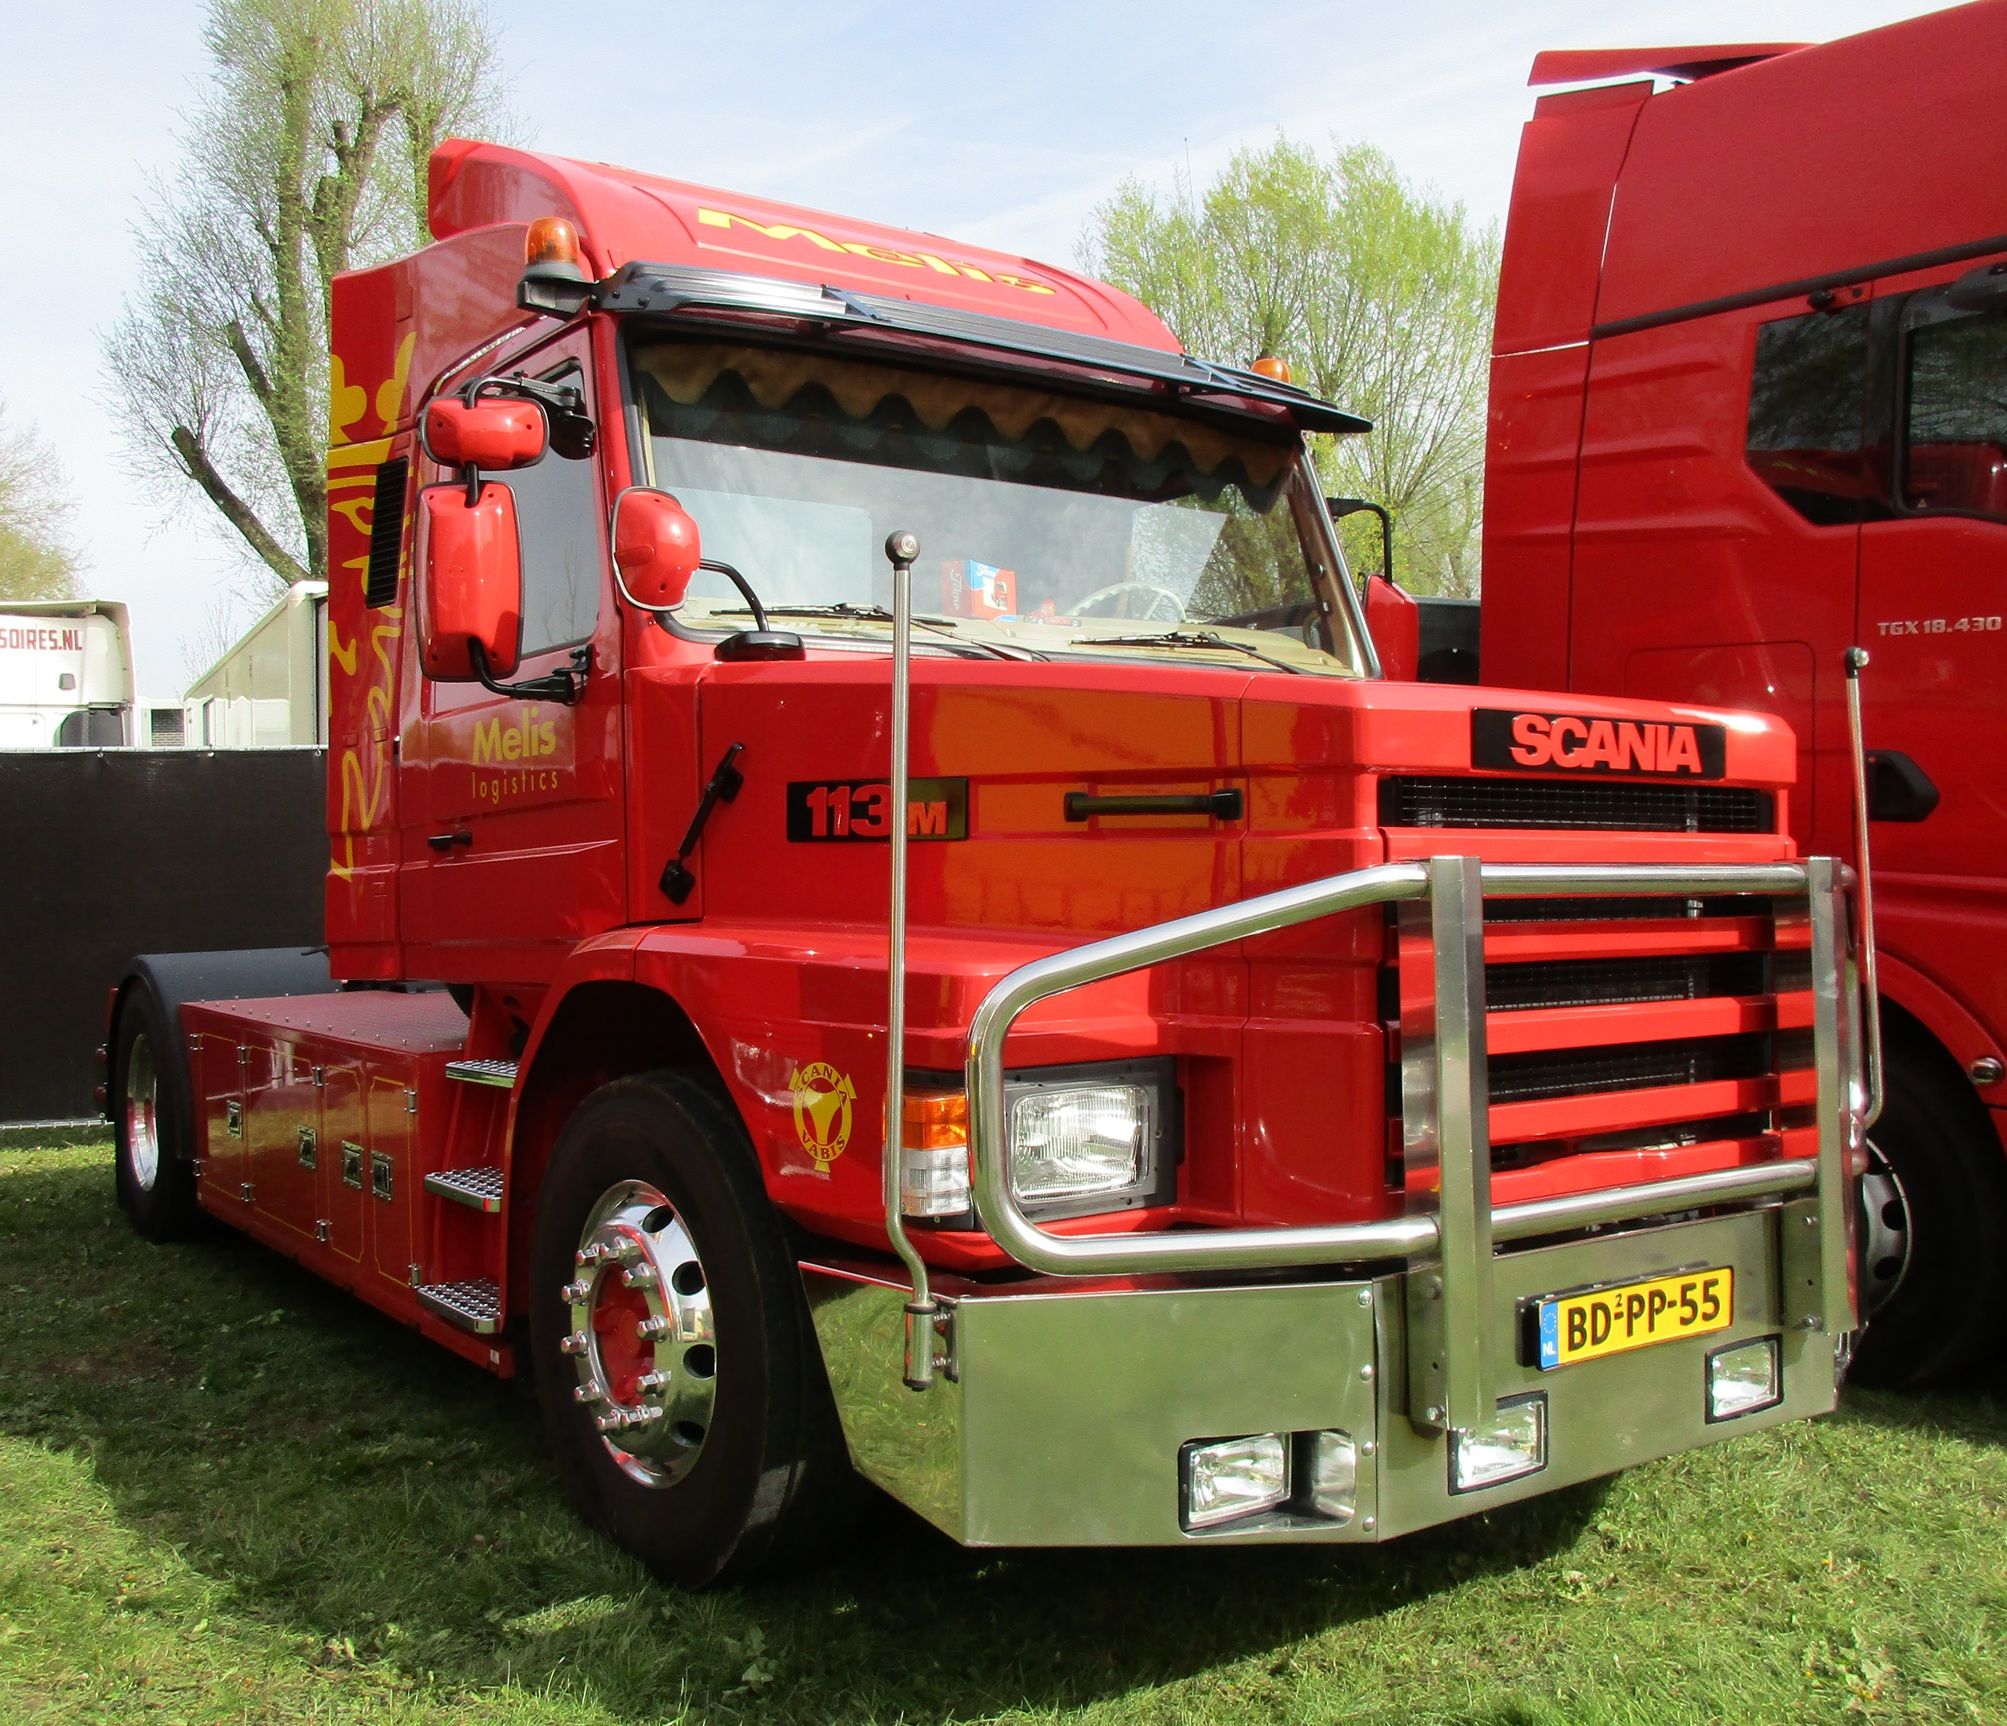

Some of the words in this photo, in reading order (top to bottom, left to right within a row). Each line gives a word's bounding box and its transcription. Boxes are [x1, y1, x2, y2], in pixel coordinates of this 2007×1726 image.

[698, 207, 1057, 295] Melis
[1877, 621, 1919, 636] TGX
[1923, 616, 2002, 634] 18.430
[472, 706, 557, 765] Melis
[1509, 713, 1703, 774] SCANIA
[472, 768, 558, 805] logistics
[806, 784, 892, 837] 113
[907, 800, 948, 836] M
[802, 1131, 845, 1159] VABIS
[1543, 1341, 1556, 1357] NL
